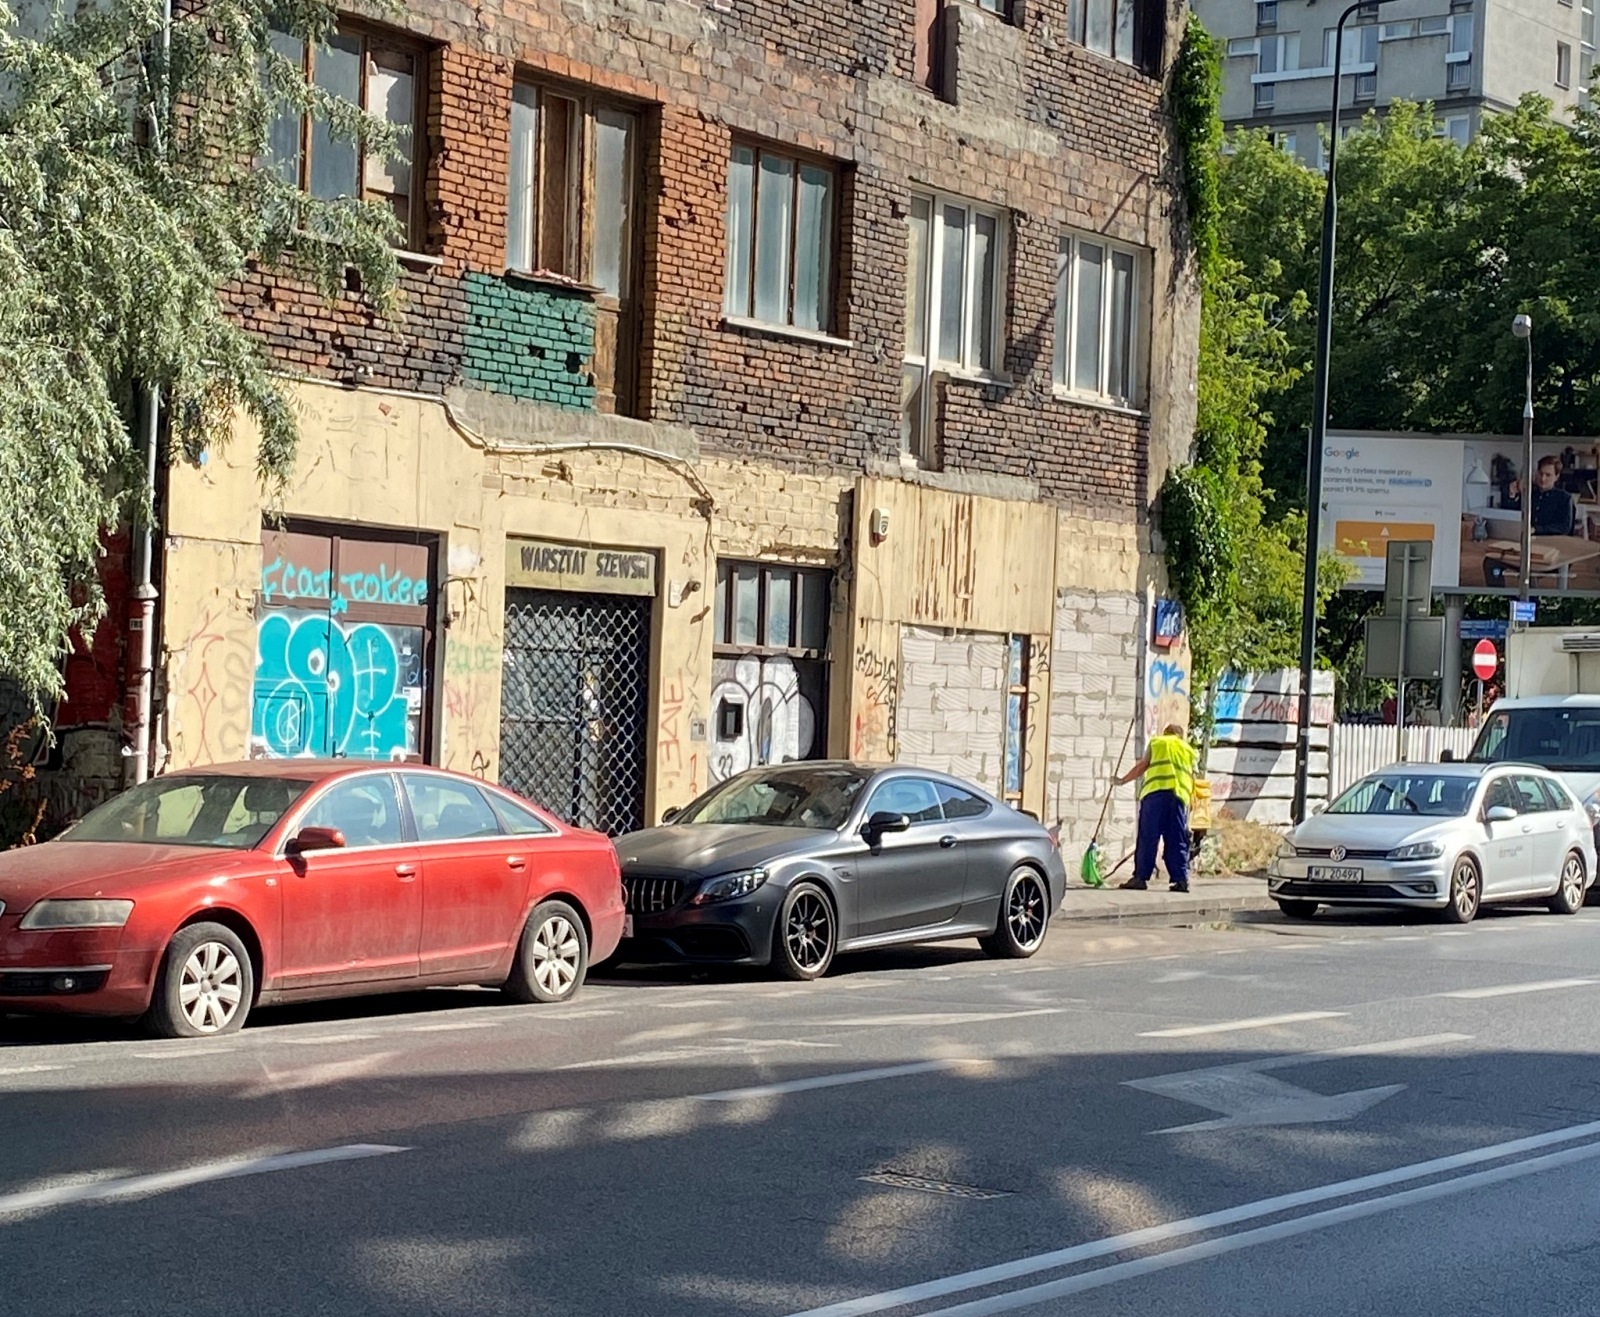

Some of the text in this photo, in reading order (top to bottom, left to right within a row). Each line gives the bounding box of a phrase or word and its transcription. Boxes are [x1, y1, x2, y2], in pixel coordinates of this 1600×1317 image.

[1323, 446, 1360, 460] Google
[520, 546, 651, 580] WARSZTAT SZEWSKI
